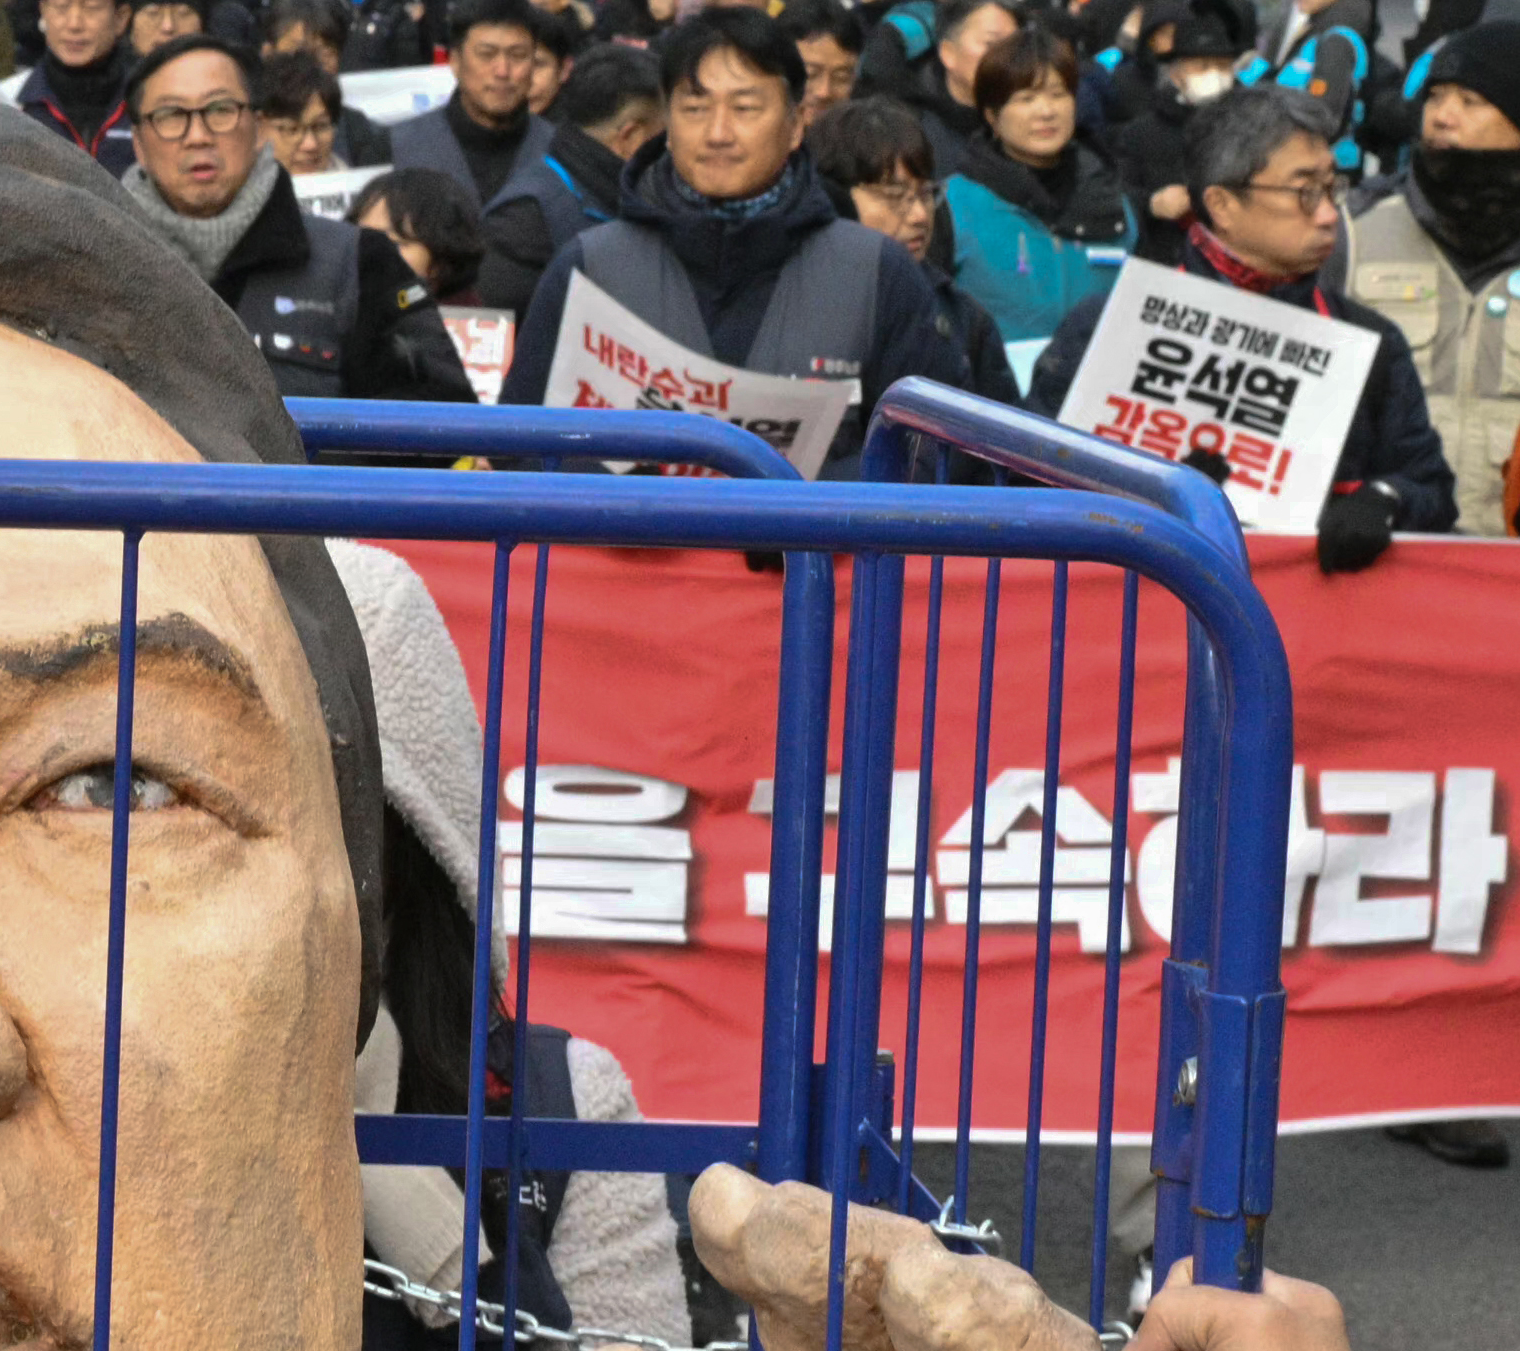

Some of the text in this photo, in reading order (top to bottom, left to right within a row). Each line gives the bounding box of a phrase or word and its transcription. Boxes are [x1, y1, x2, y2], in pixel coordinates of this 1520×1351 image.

[583, 322, 734, 412] 내란수괴
[1139, 294, 1332, 377] 망상과 광기에 빠진
[1130, 337, 1301, 439] 윤석열
